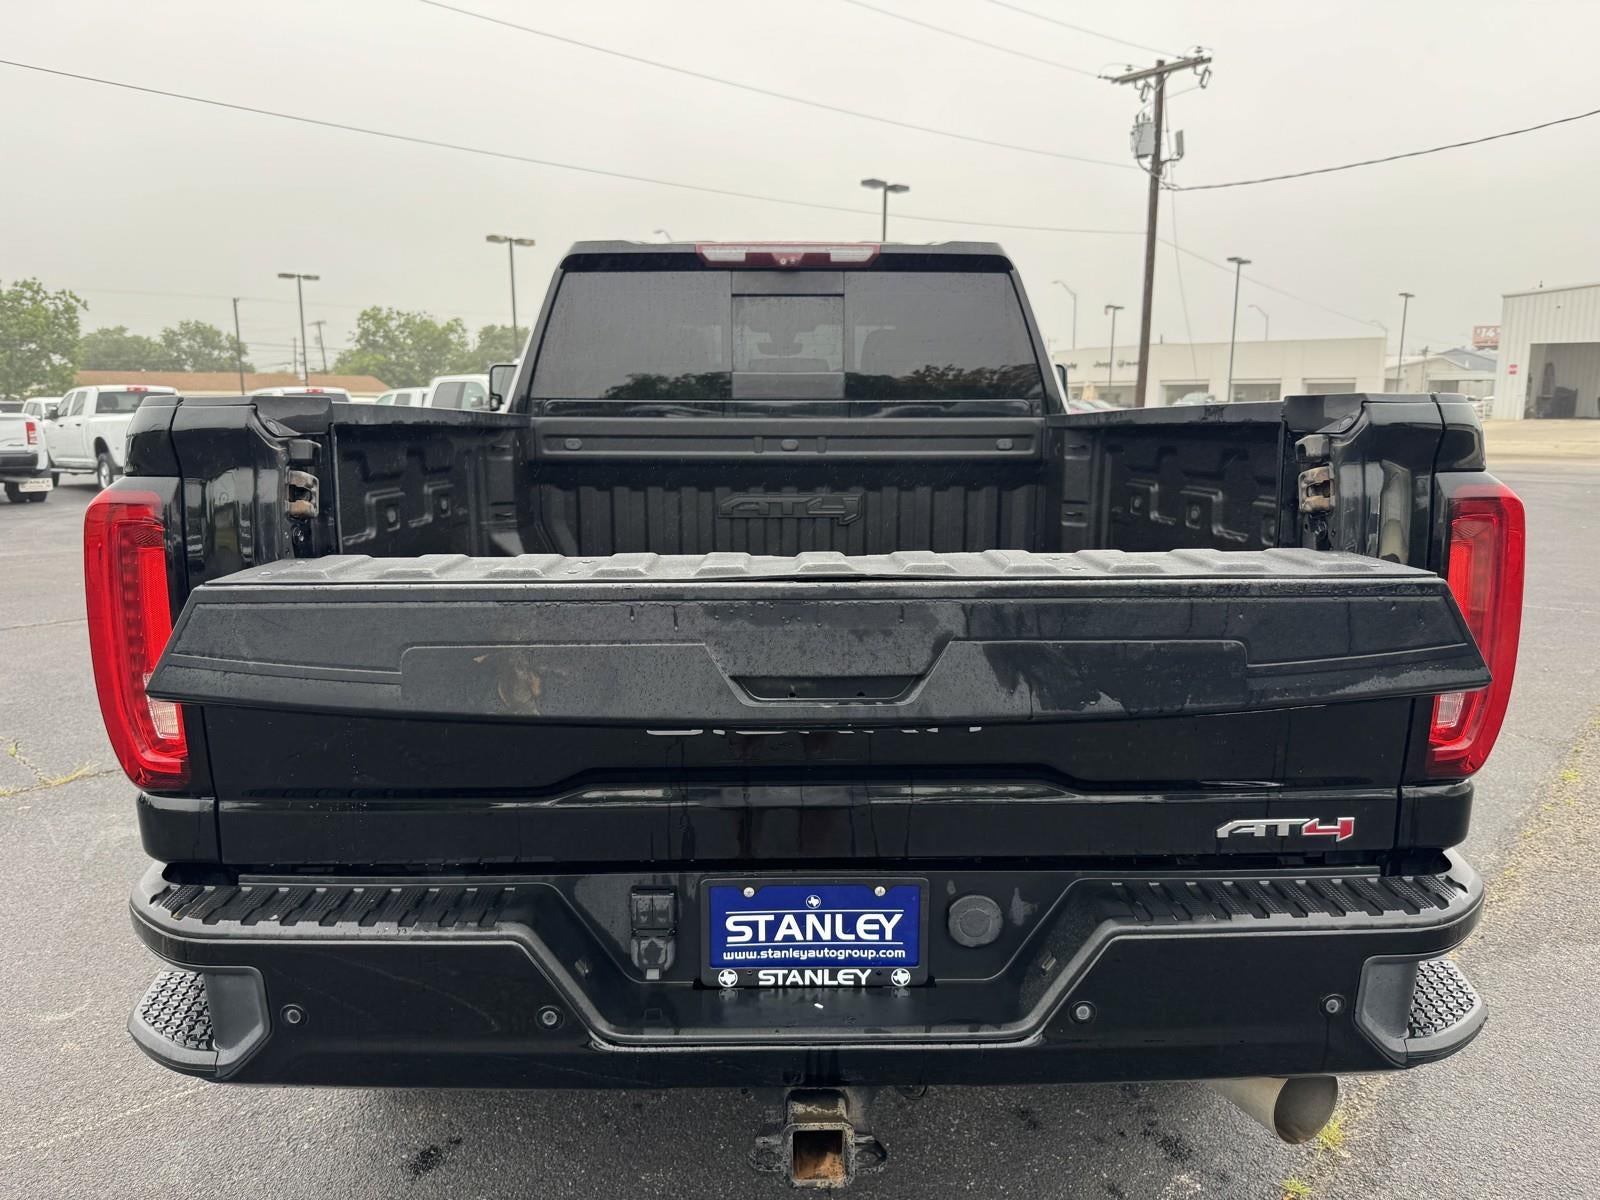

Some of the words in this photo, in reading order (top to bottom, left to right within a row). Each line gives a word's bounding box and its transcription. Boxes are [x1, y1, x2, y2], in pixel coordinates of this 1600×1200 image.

[720, 493, 863, 524] AT4
[1216, 816, 1356, 842] AT4
[724, 913, 904, 943] STANLEY
[722, 947, 906, 961] www.stanleyautogroup.com
[758, 968, 872, 986] STANLEY
